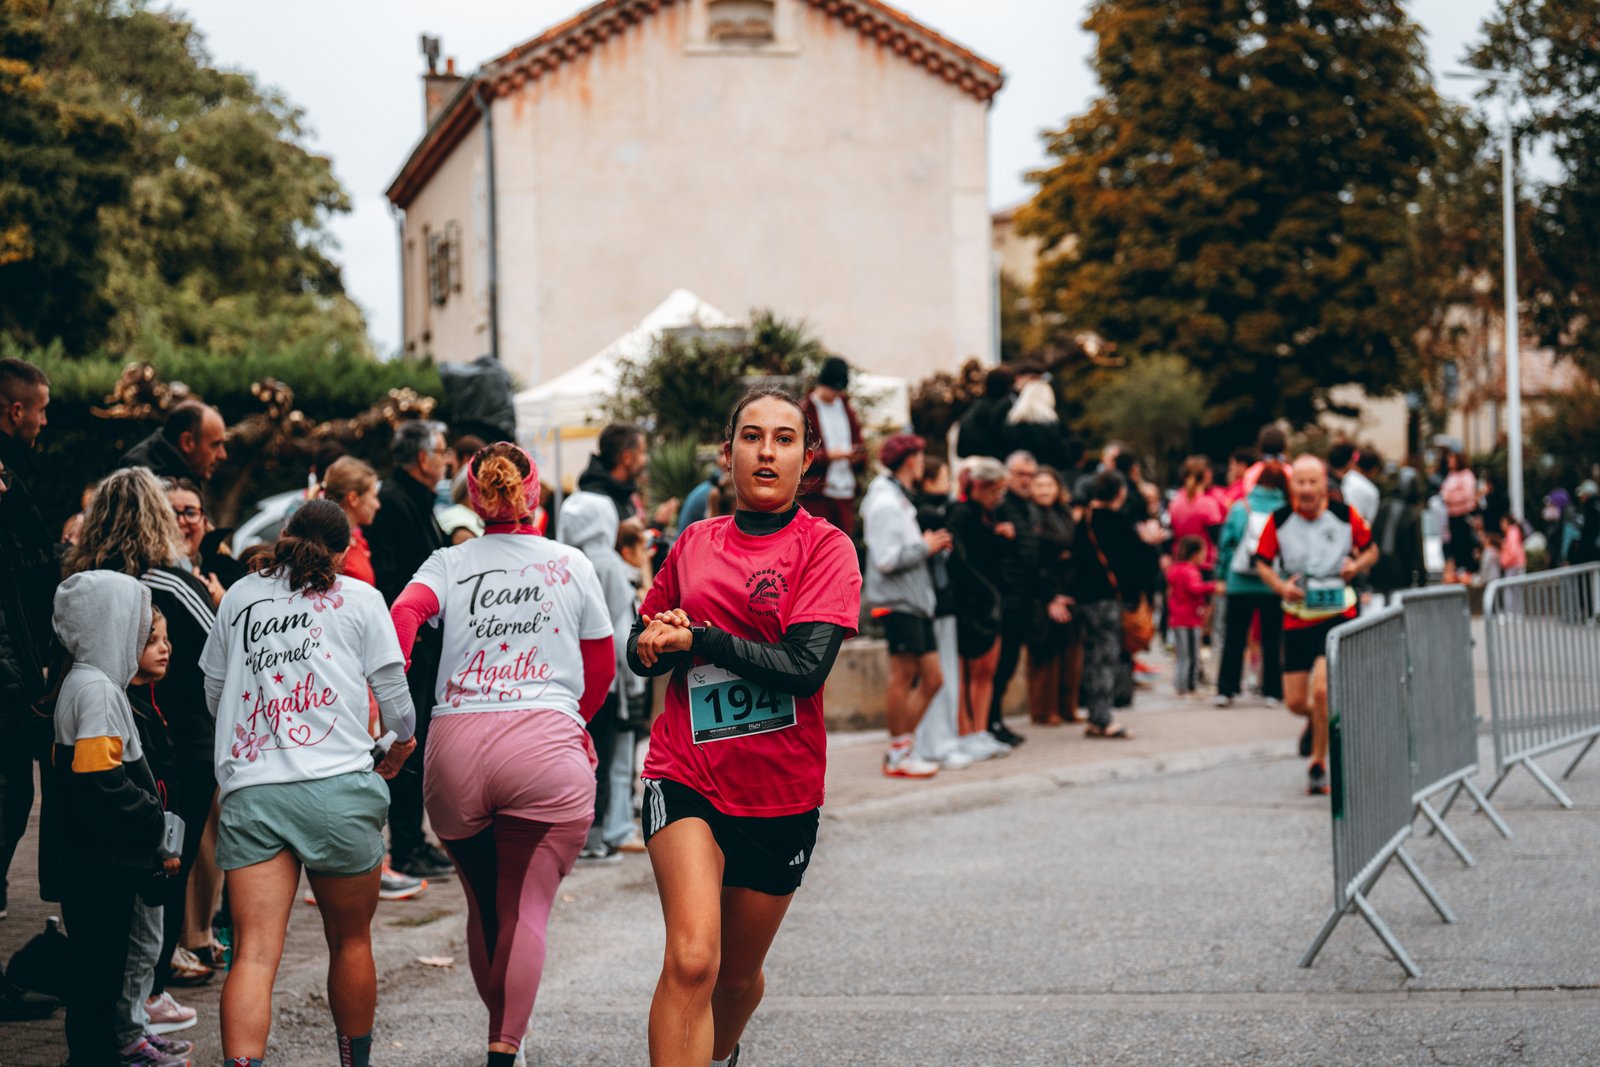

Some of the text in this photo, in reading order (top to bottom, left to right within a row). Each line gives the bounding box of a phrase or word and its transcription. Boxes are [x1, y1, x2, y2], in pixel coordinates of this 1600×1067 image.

[457, 569, 544, 615] Team
[746, 568, 789, 592] OCTOBRE ROSE
[232, 599, 313, 652] Team
[469, 612, 551, 639] “éternel”
[457, 646, 554, 695] Agathe
[247, 672, 338, 736] Agathe
[704, 684, 781, 723] 194
